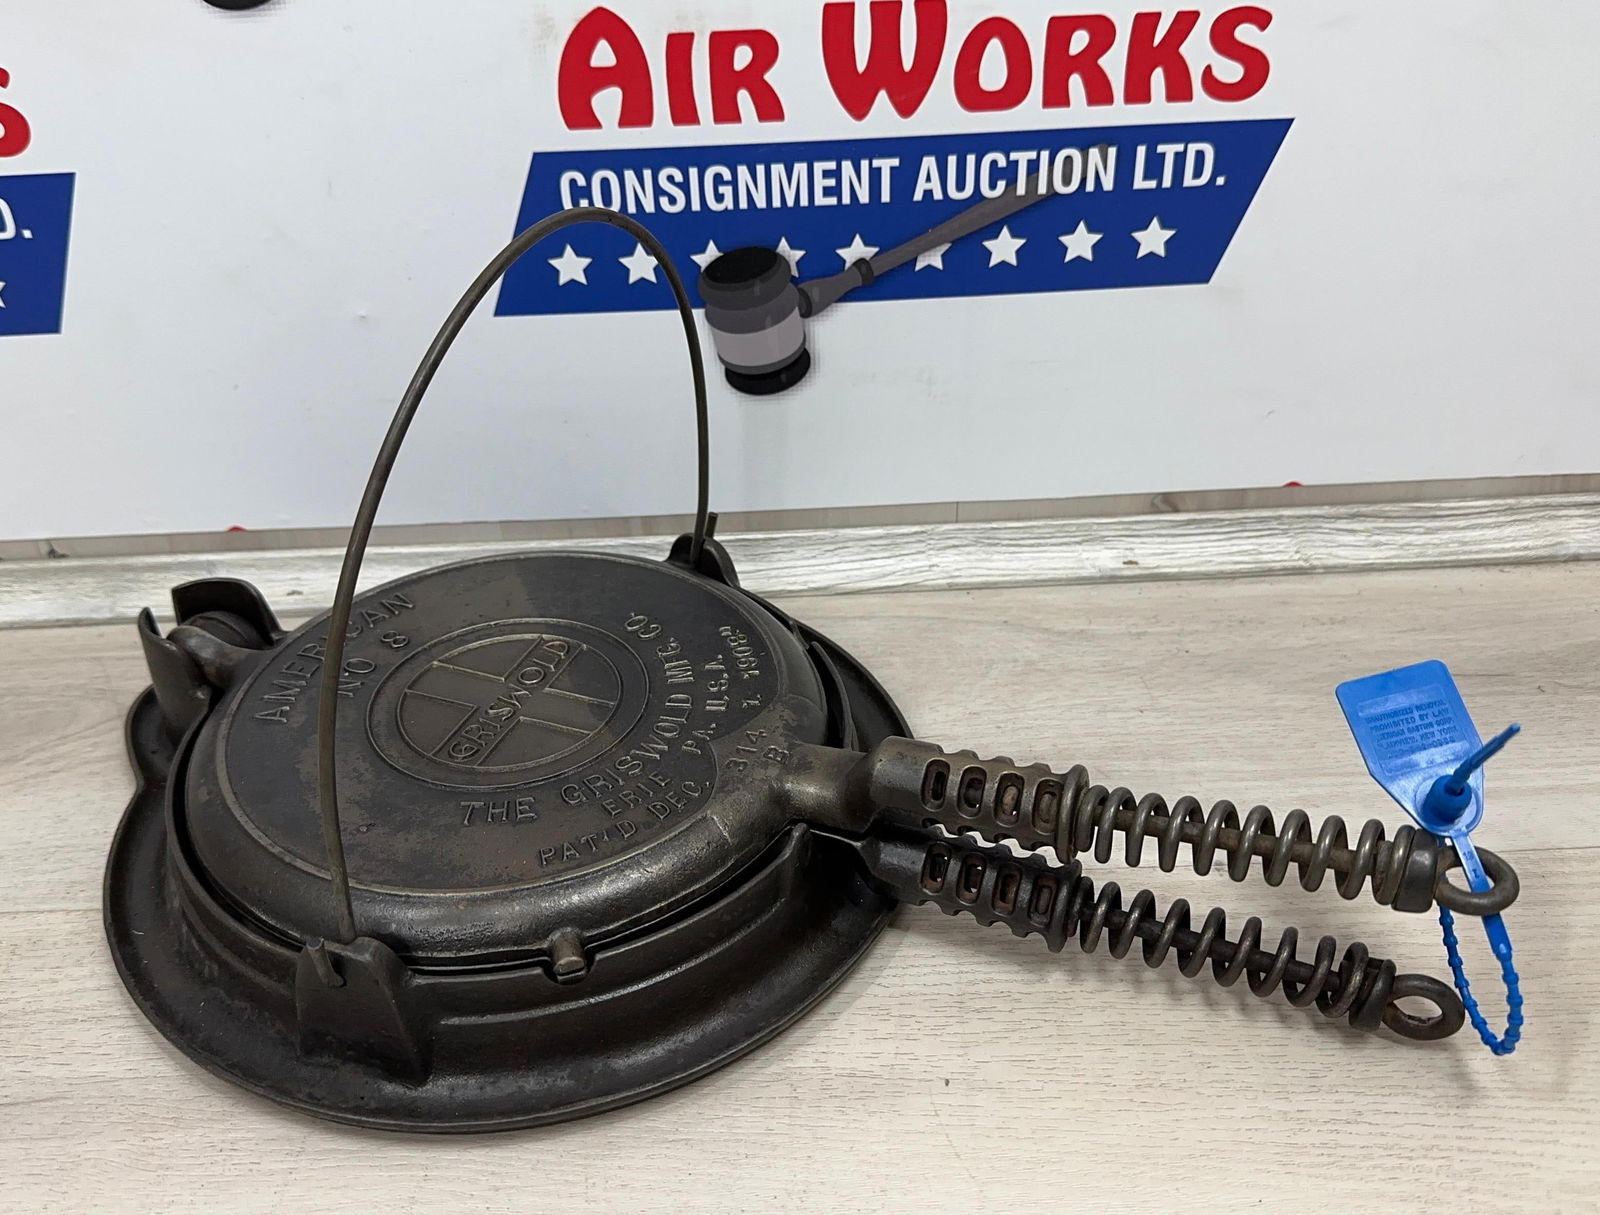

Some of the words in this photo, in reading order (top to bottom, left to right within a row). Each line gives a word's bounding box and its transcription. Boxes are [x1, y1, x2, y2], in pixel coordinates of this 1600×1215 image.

[560, 158, 900, 214] CONSIGNMENT
[913, 145, 1118, 202] AUCTION
[1132, 142, 1227, 190] LTD.
[380, 630, 409, 649] 8
[448, 639, 570, 763] GRISWOLD
[459, 796, 538, 825] THE
[561, 693, 694, 806] GRISWOLD
[602, 770, 672, 819] ERIE
[537, 819, 639, 867] PAT'D
